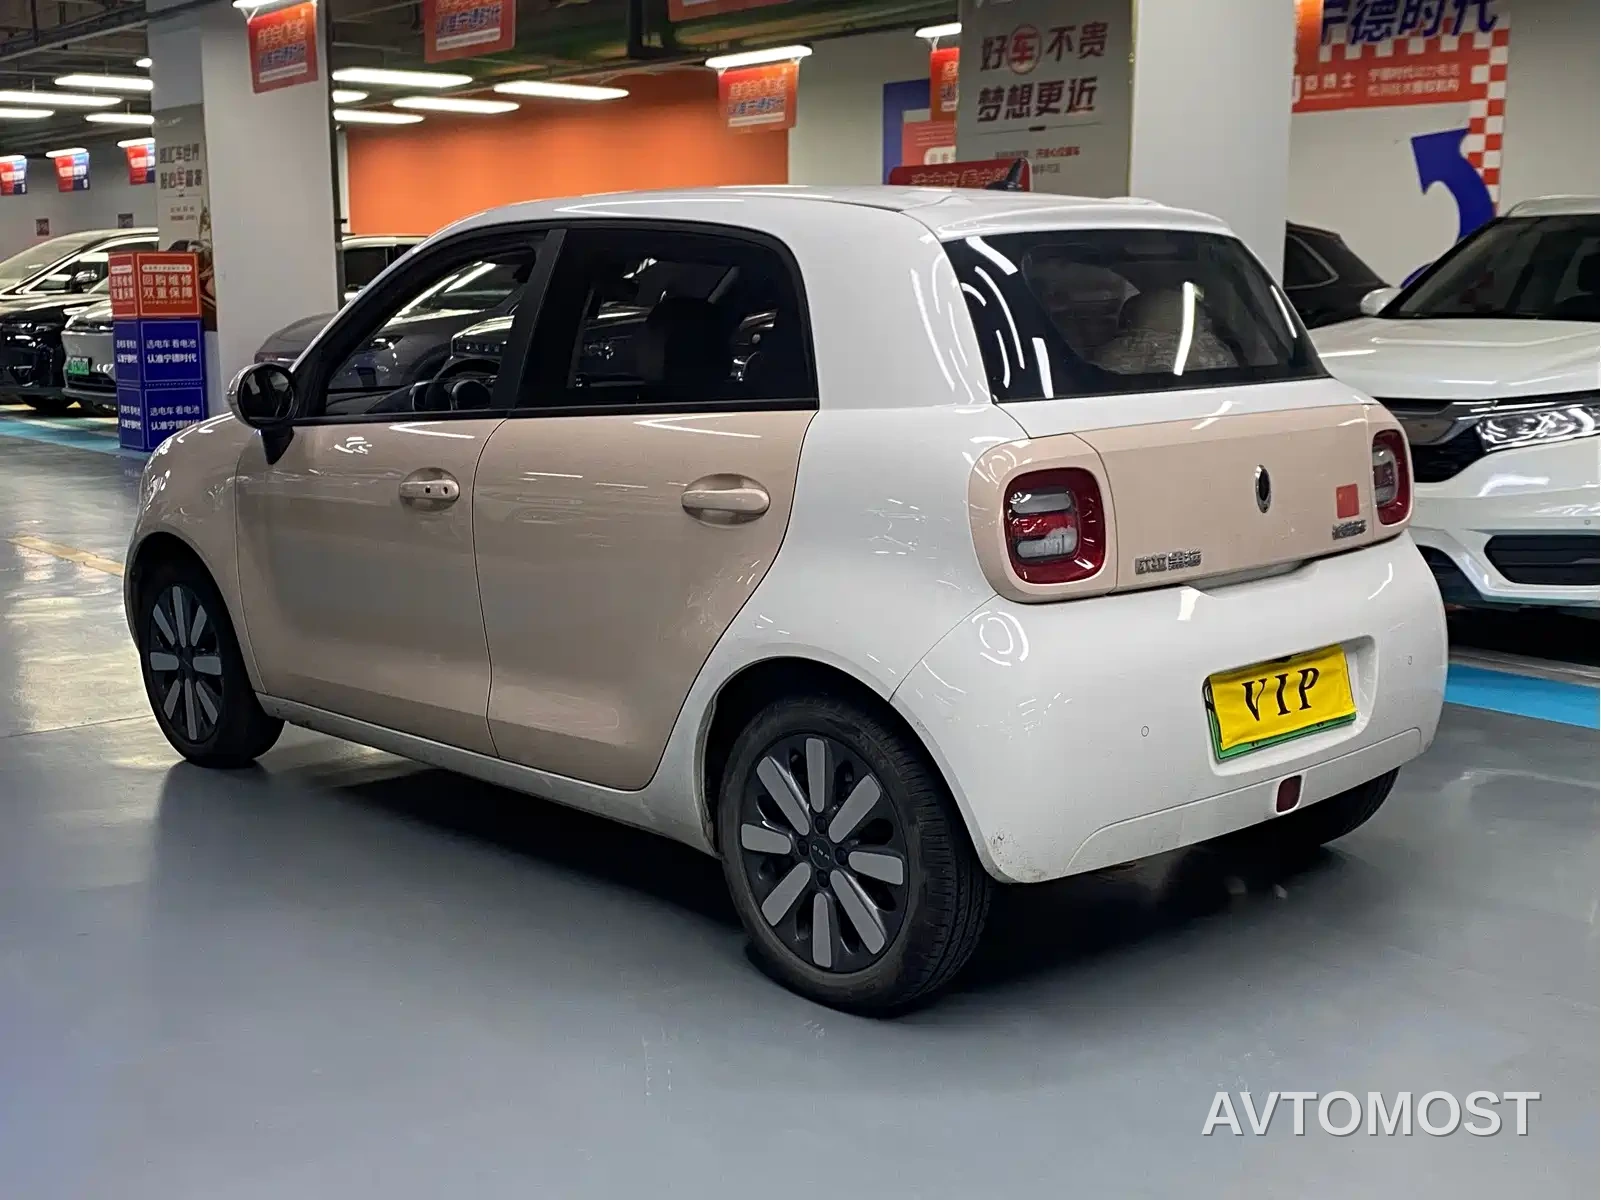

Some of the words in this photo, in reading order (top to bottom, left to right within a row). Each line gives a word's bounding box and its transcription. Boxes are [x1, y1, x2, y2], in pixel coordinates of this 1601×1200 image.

[980, 21, 1108, 73] 好车不贵
[977, 76, 1098, 123] 梦想更近
[1242, 667, 1320, 722] VIP
